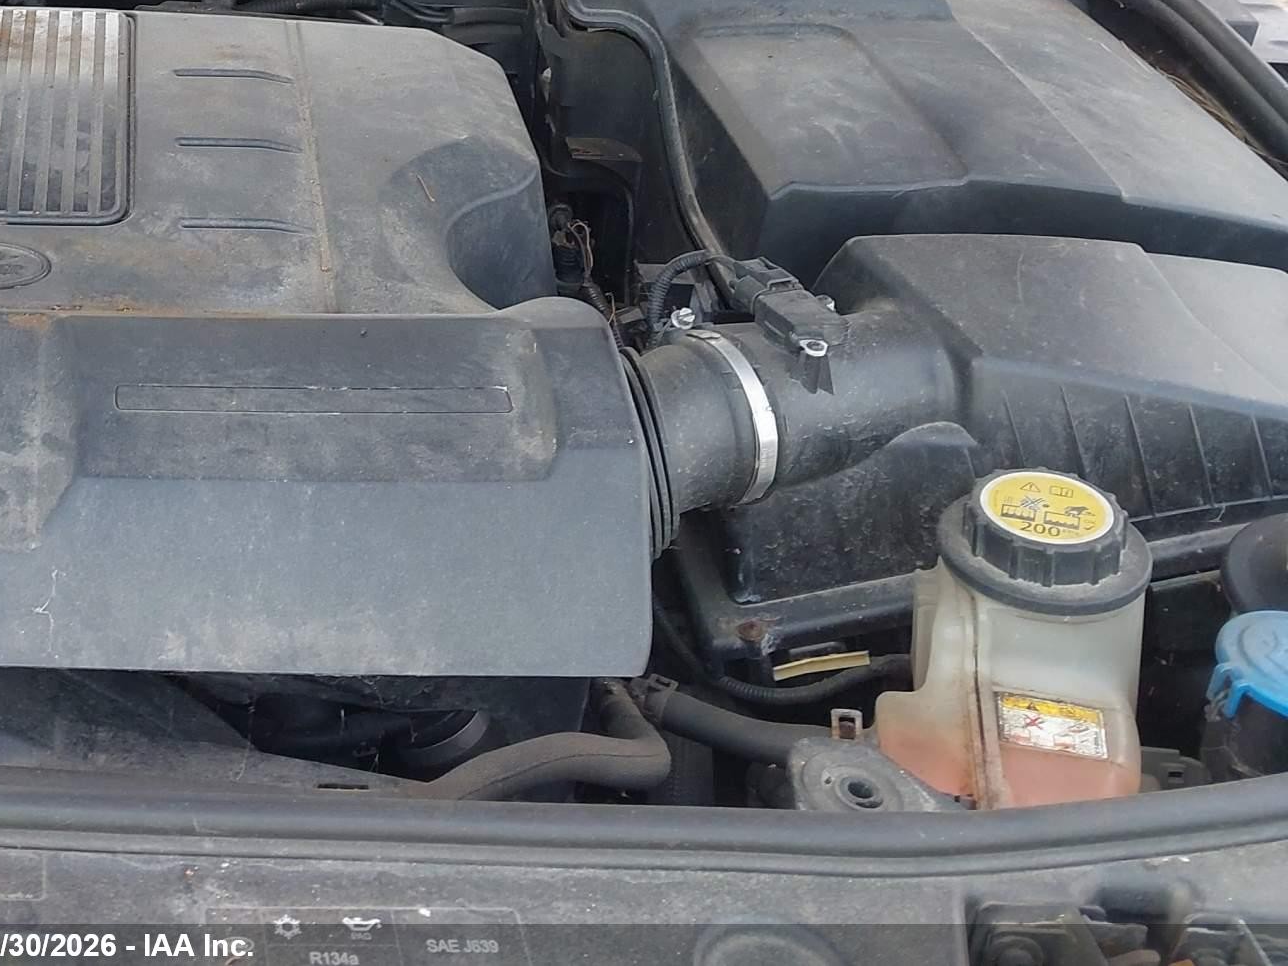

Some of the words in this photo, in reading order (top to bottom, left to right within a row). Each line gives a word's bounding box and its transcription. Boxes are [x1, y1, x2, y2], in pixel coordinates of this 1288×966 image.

[1019, 521, 1061, 538] 200
[426, 939, 458, 953] SAE
[309, 951, 360, 965] R134a
